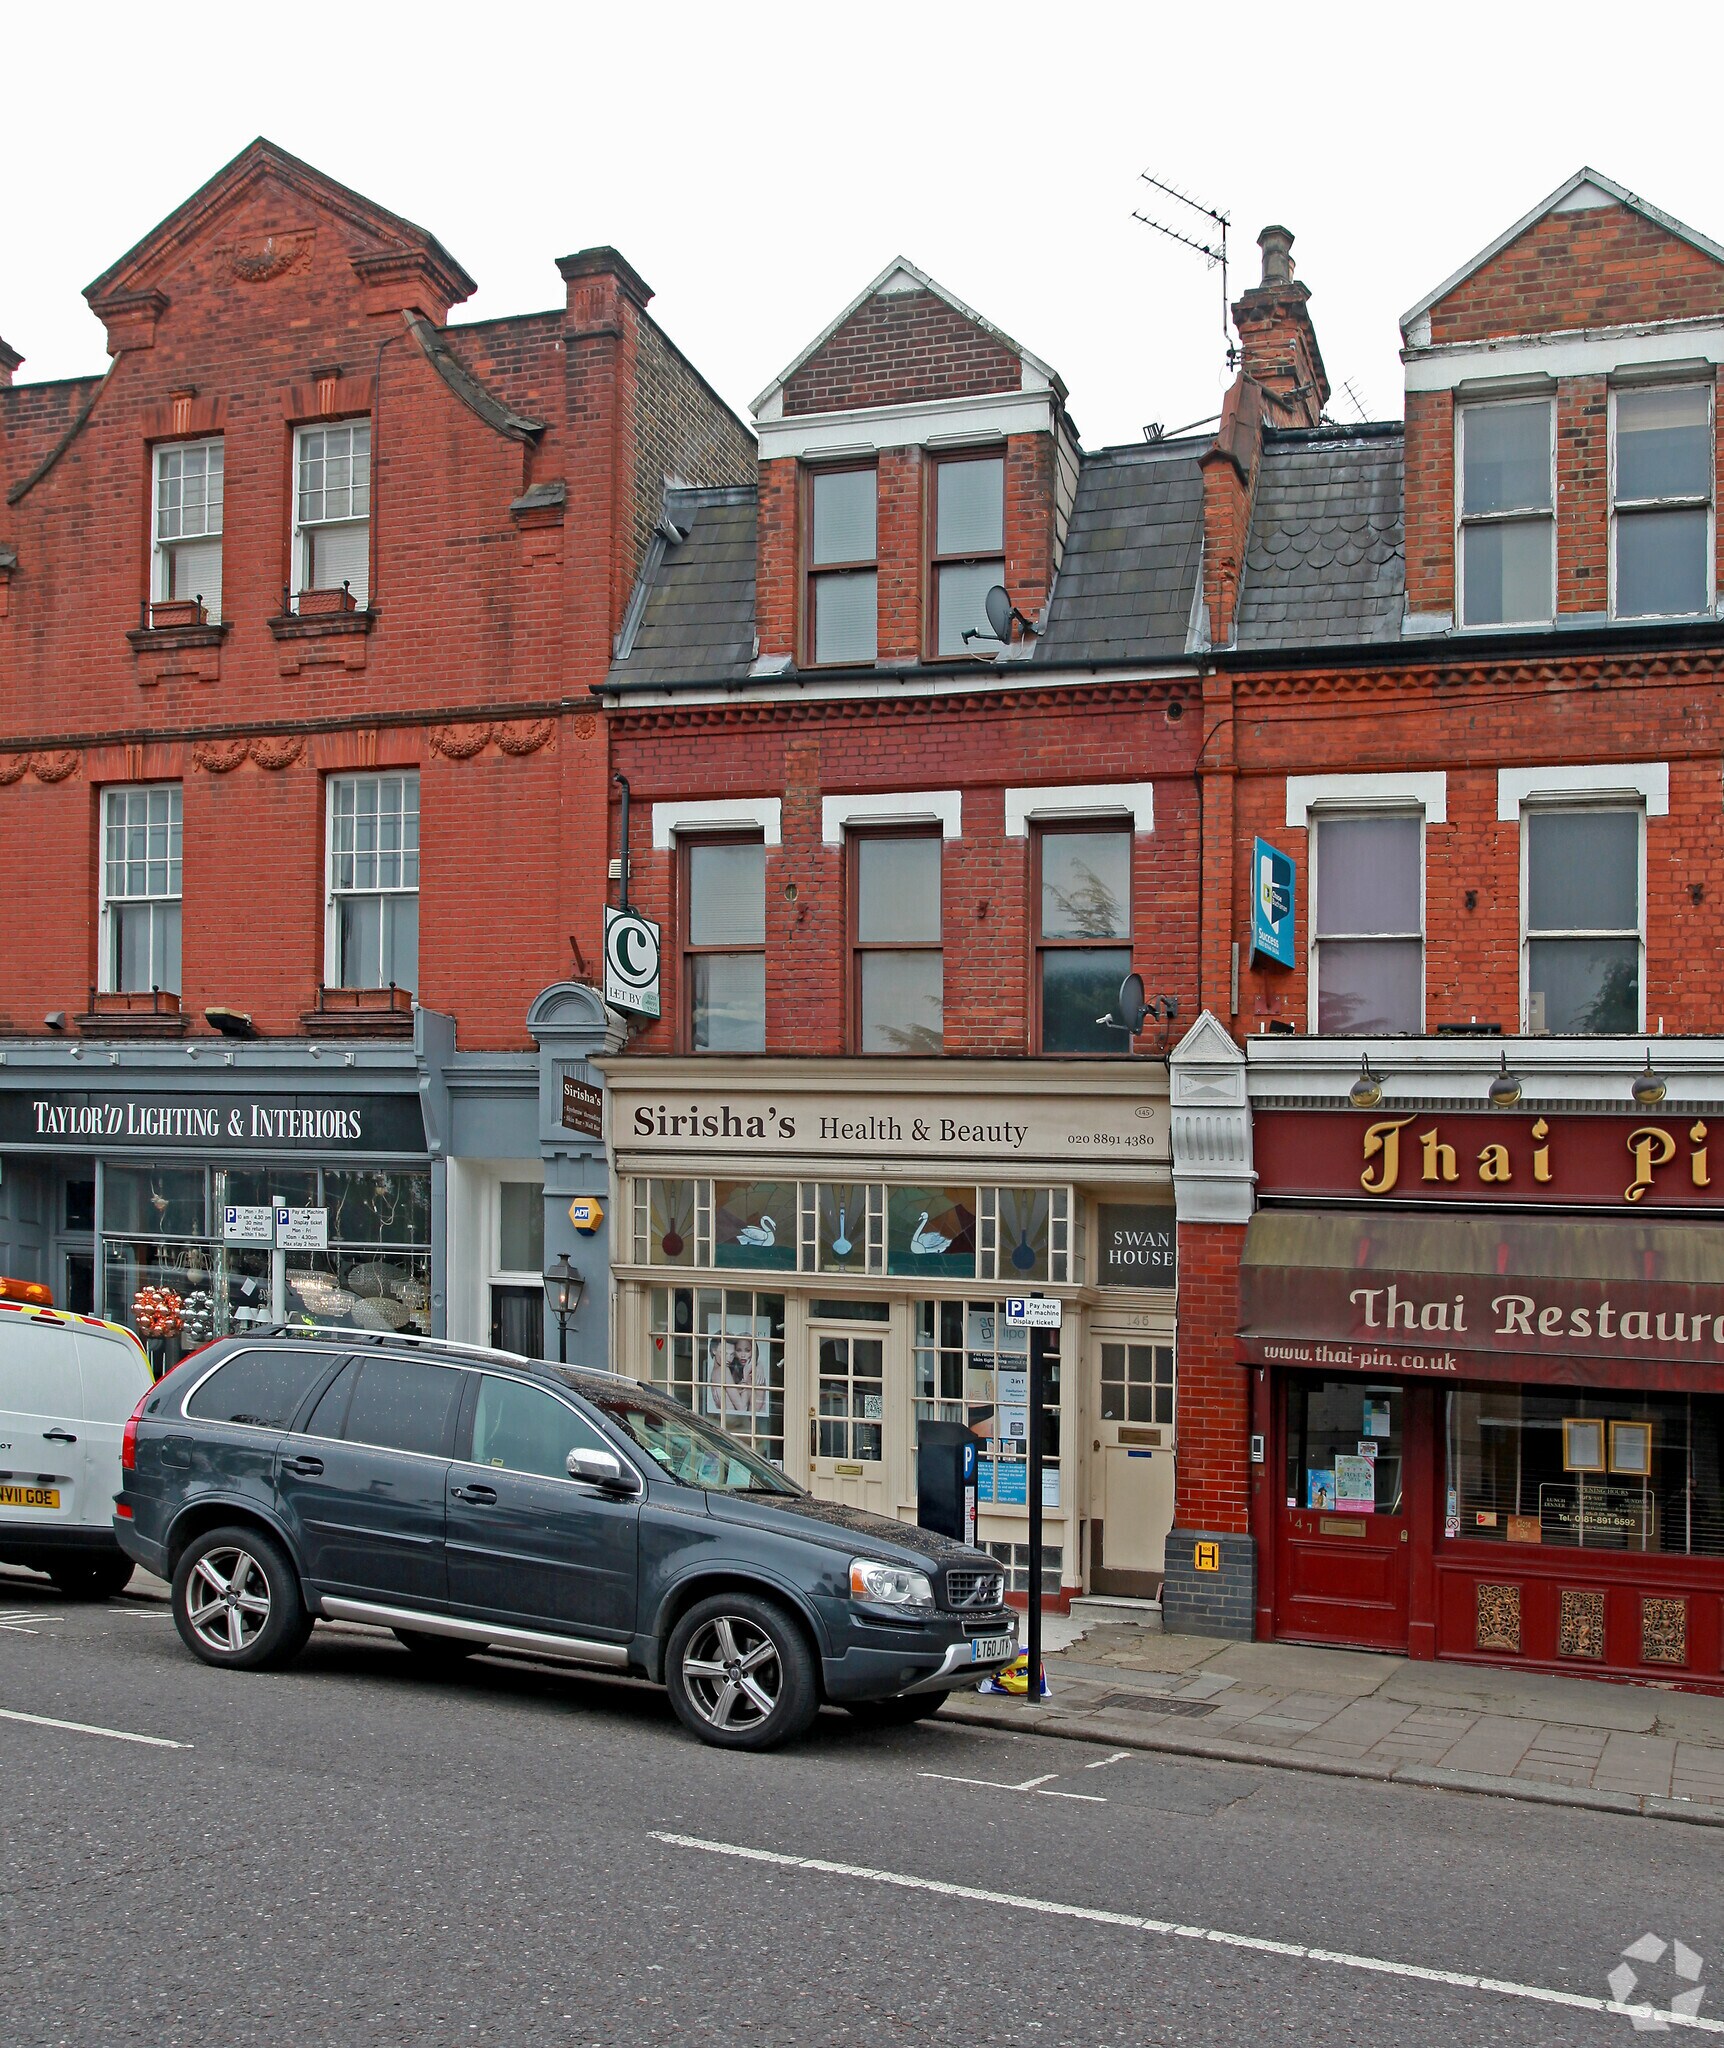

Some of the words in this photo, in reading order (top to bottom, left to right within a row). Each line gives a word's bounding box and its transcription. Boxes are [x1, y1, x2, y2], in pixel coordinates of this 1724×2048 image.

[1258, 928, 1279, 948] Success
[616, 926, 647, 977] C
[609, 987, 627, 1001] LET
[629, 991, 641, 1005] BY
[564, 1083, 601, 1107] Sirisha's
[126, 1103, 220, 1137] LIGHTING
[227, 1108, 245, 1137] &
[250, 1104, 362, 1139] INTERIORS
[1137, 1109, 1151, 1117] 145
[633, 1105, 796, 1139] Sirisha's
[819, 1116, 903, 1141] Health
[911, 1118, 931, 1142] &
[939, 1118, 1029, 1149] Beauty
[1067, 1135, 1090, 1144] 020
[1093, 1133, 1121, 1145] 8891
[1124, 1134, 1155, 1147] 4380
[1361, 1113, 1553, 1194] Thai
[227, 1208, 235, 1222] P
[279, 1210, 287, 1224] P
[575, 1209, 589, 1218] ADT
[1114, 1230, 1170, 1247] SWAN
[1109, 1249, 1174, 1266] HOUSE
[1011, 1300, 1022, 1316] P
[1349, 1284, 1468, 1332] Thai
[1012, 1318, 1034, 1326] Display
[1003, 1328, 1026, 1340] lipo
[965, 1446, 972, 1472] P
[26, 1489, 52, 1505] GOE
[1558, 1514, 1572, 1522] Tel.
[1614, 1518, 1636, 1527] 6592
[1198, 1544, 1216, 1568] H
